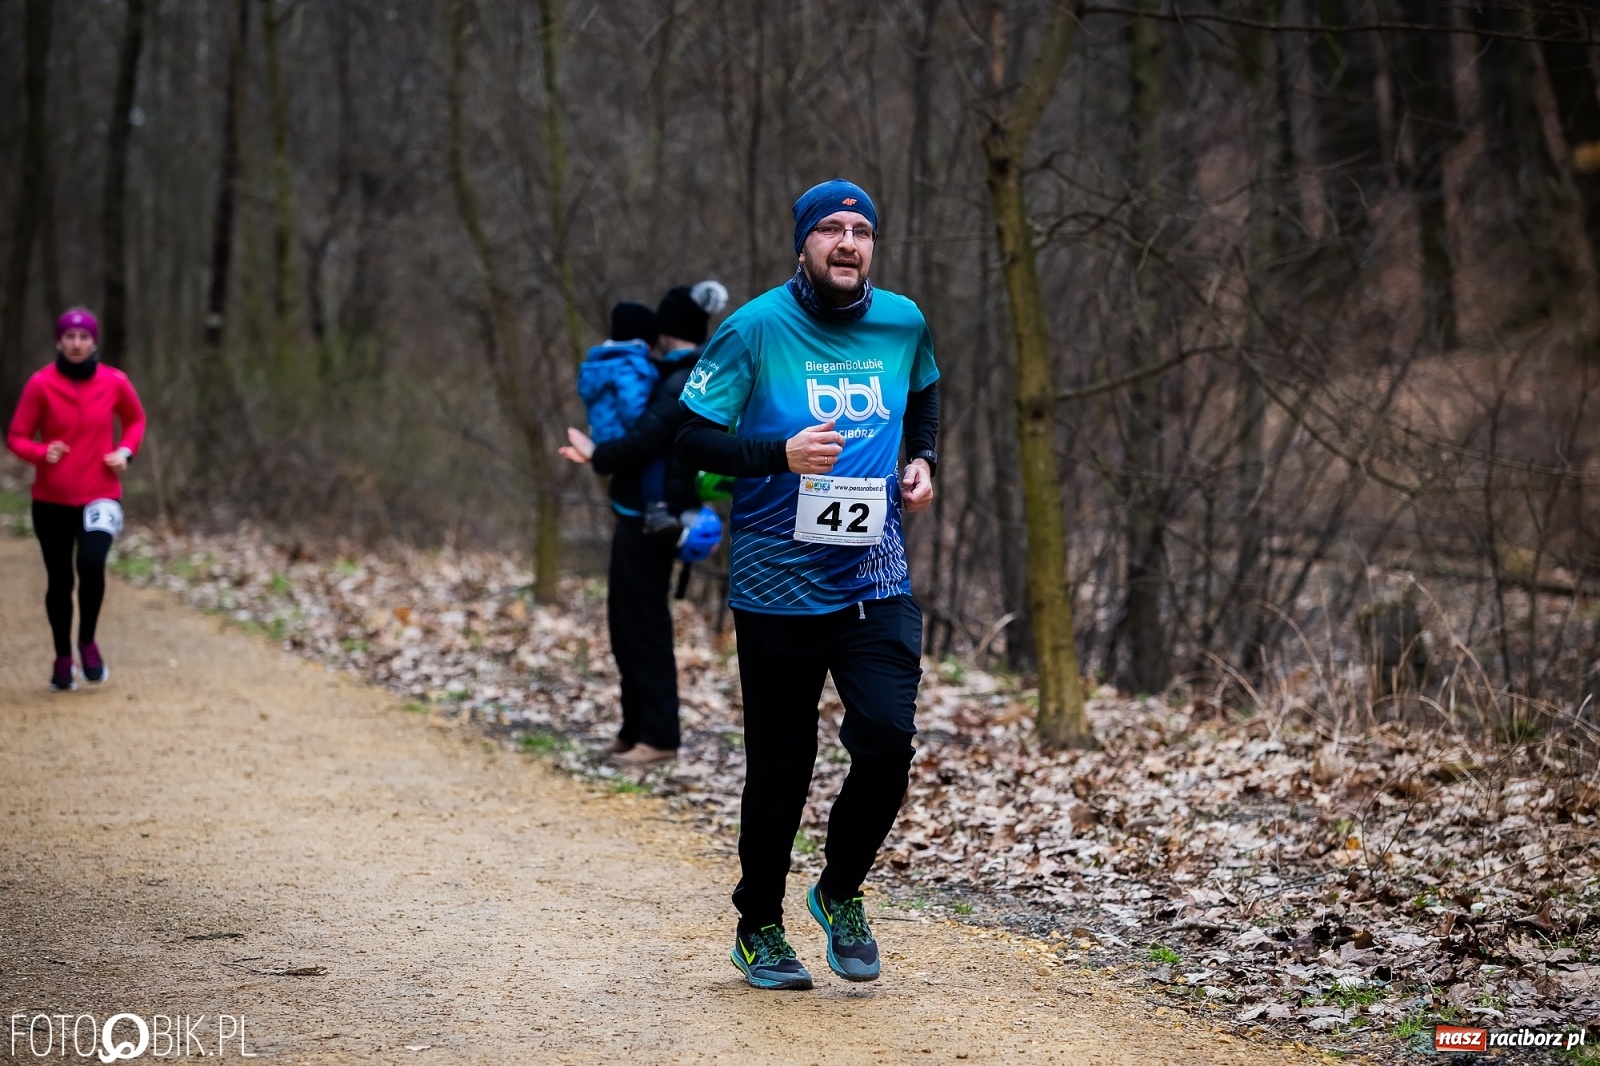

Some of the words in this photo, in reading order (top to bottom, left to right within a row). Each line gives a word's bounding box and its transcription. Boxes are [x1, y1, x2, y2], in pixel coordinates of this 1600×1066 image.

[842, 197, 857, 206] 4F
[805, 359, 884, 373] BiegamBoLubię
[806, 376, 891, 422] bbl
[838, 427, 874, 439] CIBÓRZ
[834, 484, 884, 493] www.personalbest.pl
[816, 501, 870, 533] 42
